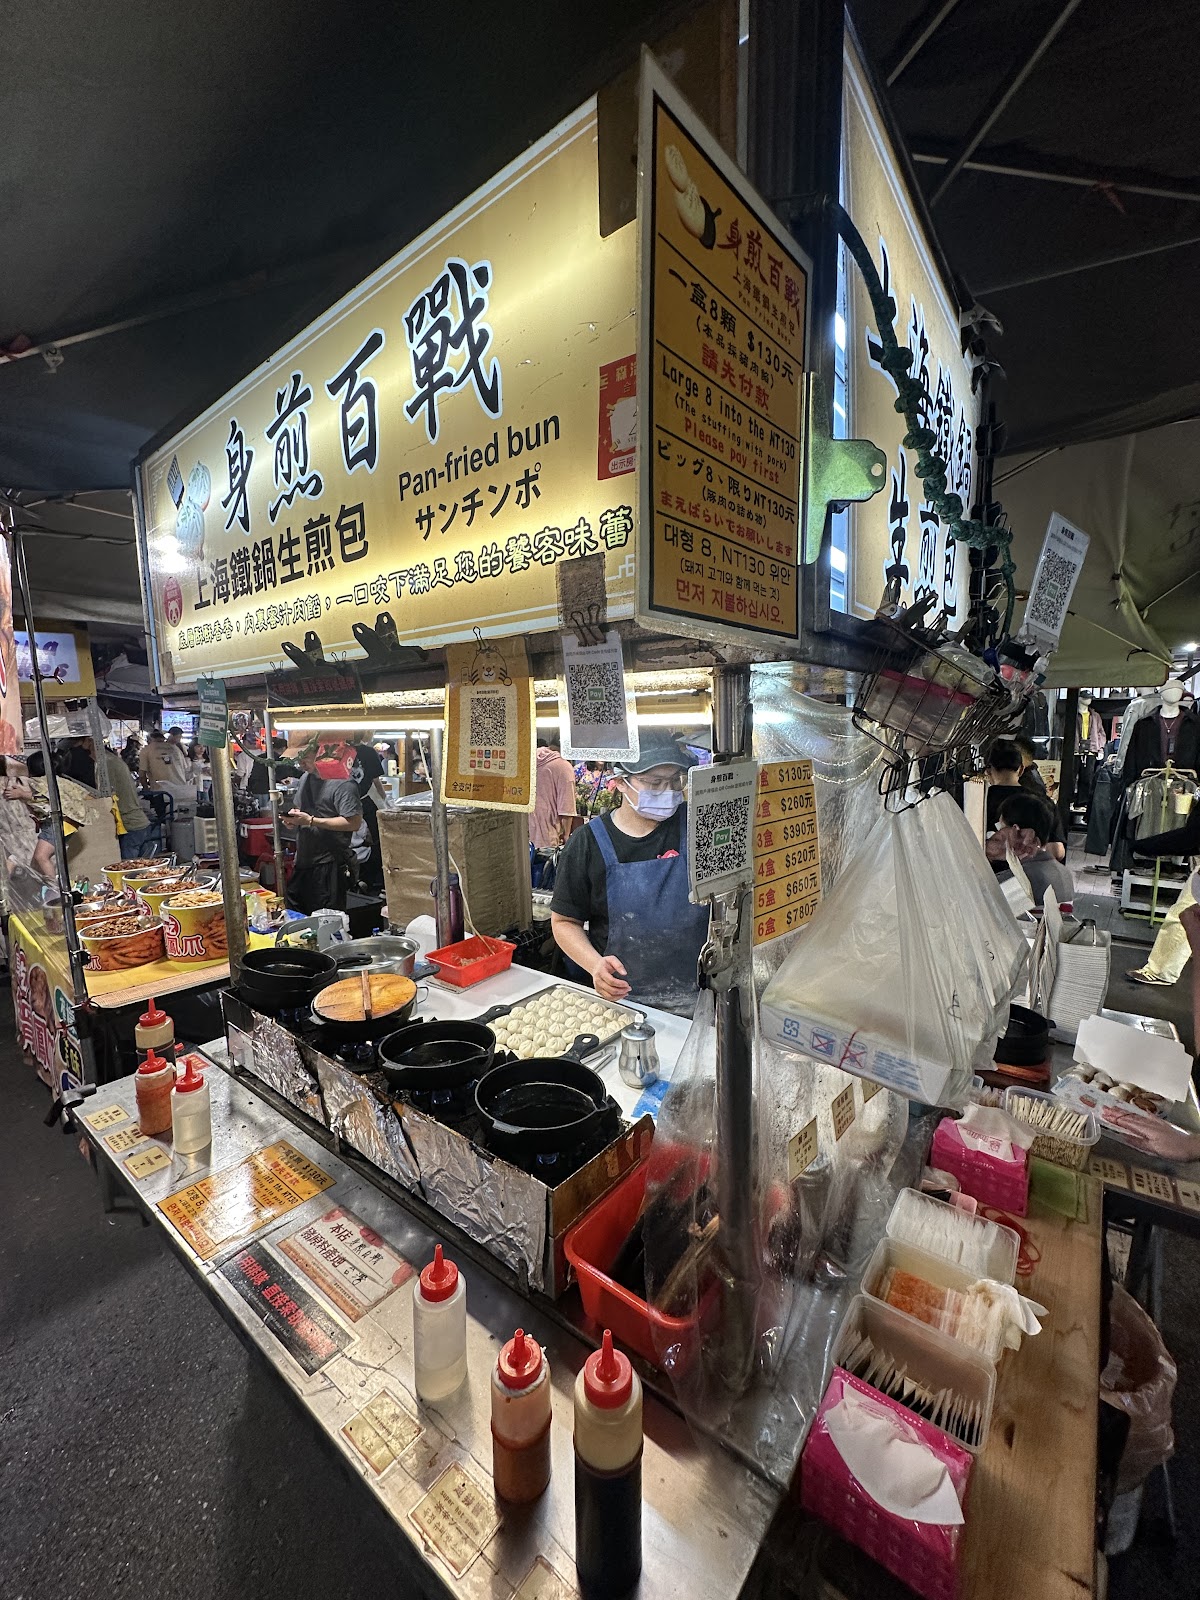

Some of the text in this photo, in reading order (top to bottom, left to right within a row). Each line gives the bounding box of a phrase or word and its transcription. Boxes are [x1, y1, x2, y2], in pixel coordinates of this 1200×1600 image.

[717, 218, 800, 328] 身煎百戰
[668, 268, 793, 385] 一盒8顆 $130元
[220, 260, 501, 534] 身煎百戰
[702, 343, 769, 410] 請先付款
[662, 355, 699, 398] Large
[705, 386, 712, 406] 8
[719, 396, 742, 426] into
[749, 416, 764, 441] the
[769, 430, 795, 460] NT130
[675, 392, 787, 473] (The stuffing with pork)
[684, 417, 779, 484] Please pay first
[398, 415, 560, 501] Pan-fried bun
[415, 462, 542, 541] サンチンポ
[193, 502, 369, 611] 上海鐵鍋生煎包
[664, 523, 791, 585] 대형 8, NT130 위안
[680, 557, 704, 577] (돼지
[708, 566, 733, 586] 고기와
[676, 578, 784, 625] 먼저 지불하십시오.
[778, 764, 812, 783] $130元
[756, 792, 813, 819] 2盒 $260元
[715, 832, 728, 842] Pay
[756, 818, 815, 848] 3盒 $390元
[757, 844, 816, 878] 4盒 $520元
[758, 871, 818, 908] 5盒 $650元
[757, 898, 818, 937] 6盒 $780元
[302, 1164, 328, 1185] $130元
[301, 1226, 346, 1268] 豬原料產地
[330, 1222, 354, 1242] 本店
[440, 1490, 455, 1506] super
[454, 1506, 465, 1518] hot
